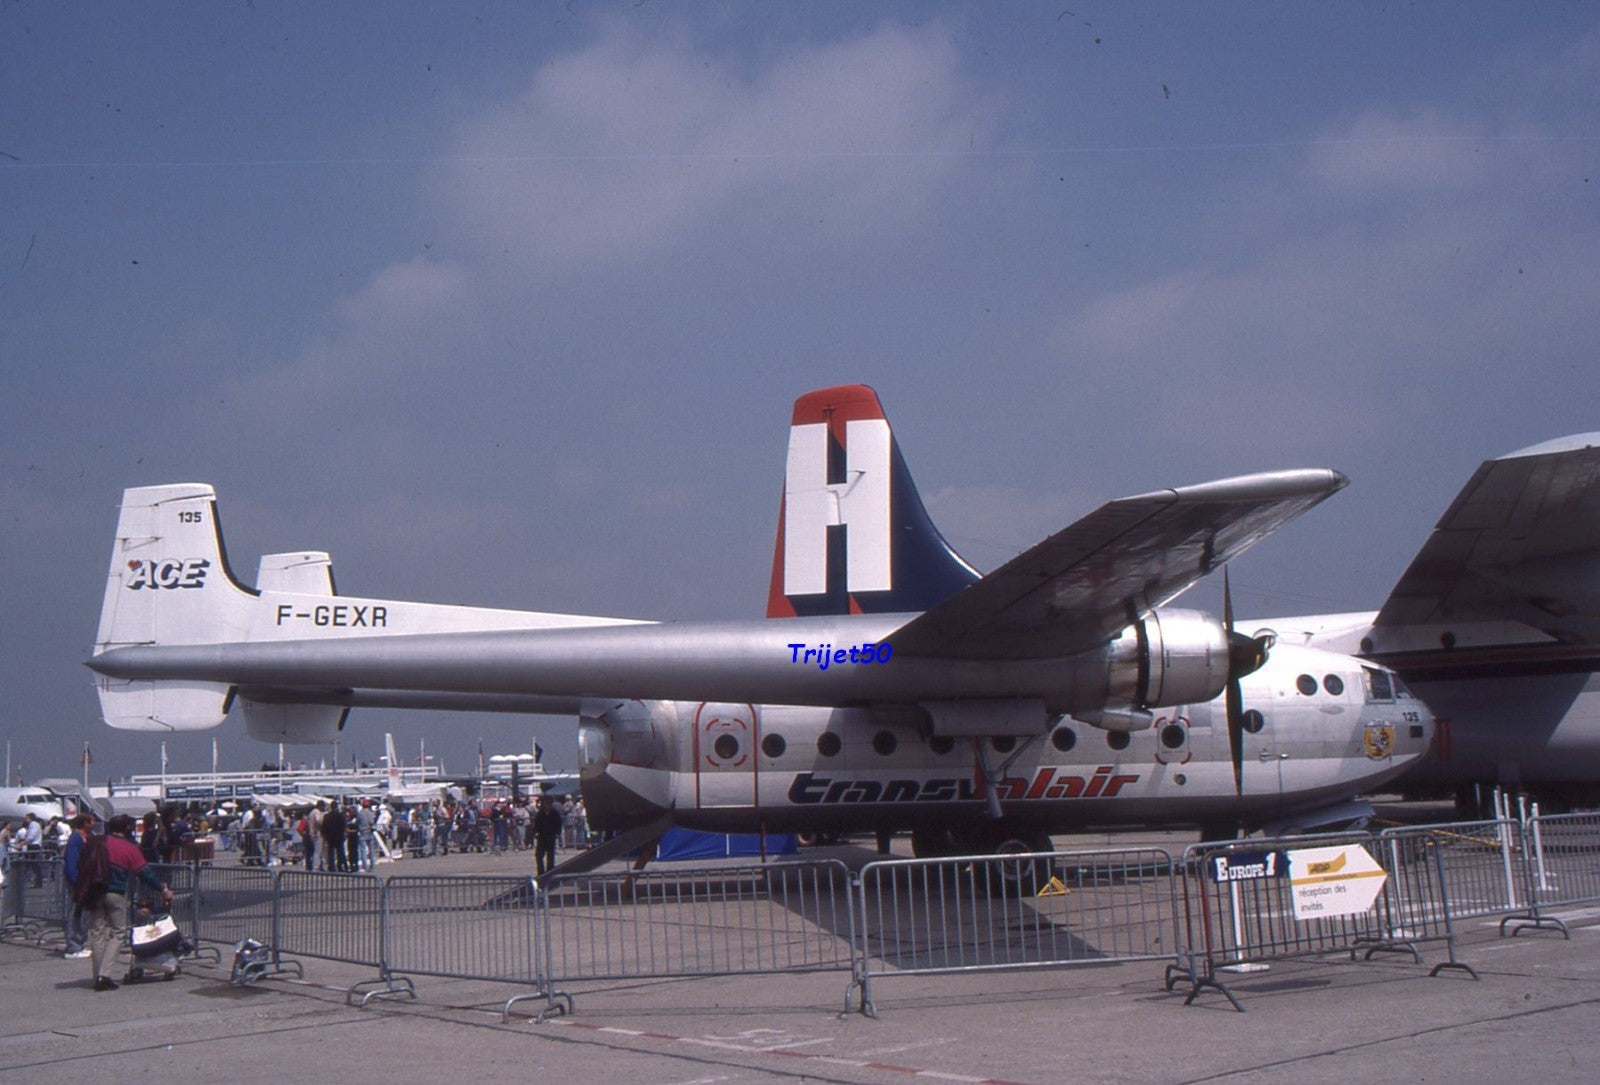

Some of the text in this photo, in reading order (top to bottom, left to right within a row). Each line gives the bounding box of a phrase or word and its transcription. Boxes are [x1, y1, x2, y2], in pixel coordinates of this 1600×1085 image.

[177, 511, 203, 523] 135
[126, 558, 211, 590] ACE
[276, 604, 388, 627] F-GEXR
[1402, 712, 1419, 722] 135
[1265, 852, 1276, 876] 1
[1299, 884, 1347, 898] réception des
[1301, 901, 1324, 911] invités
